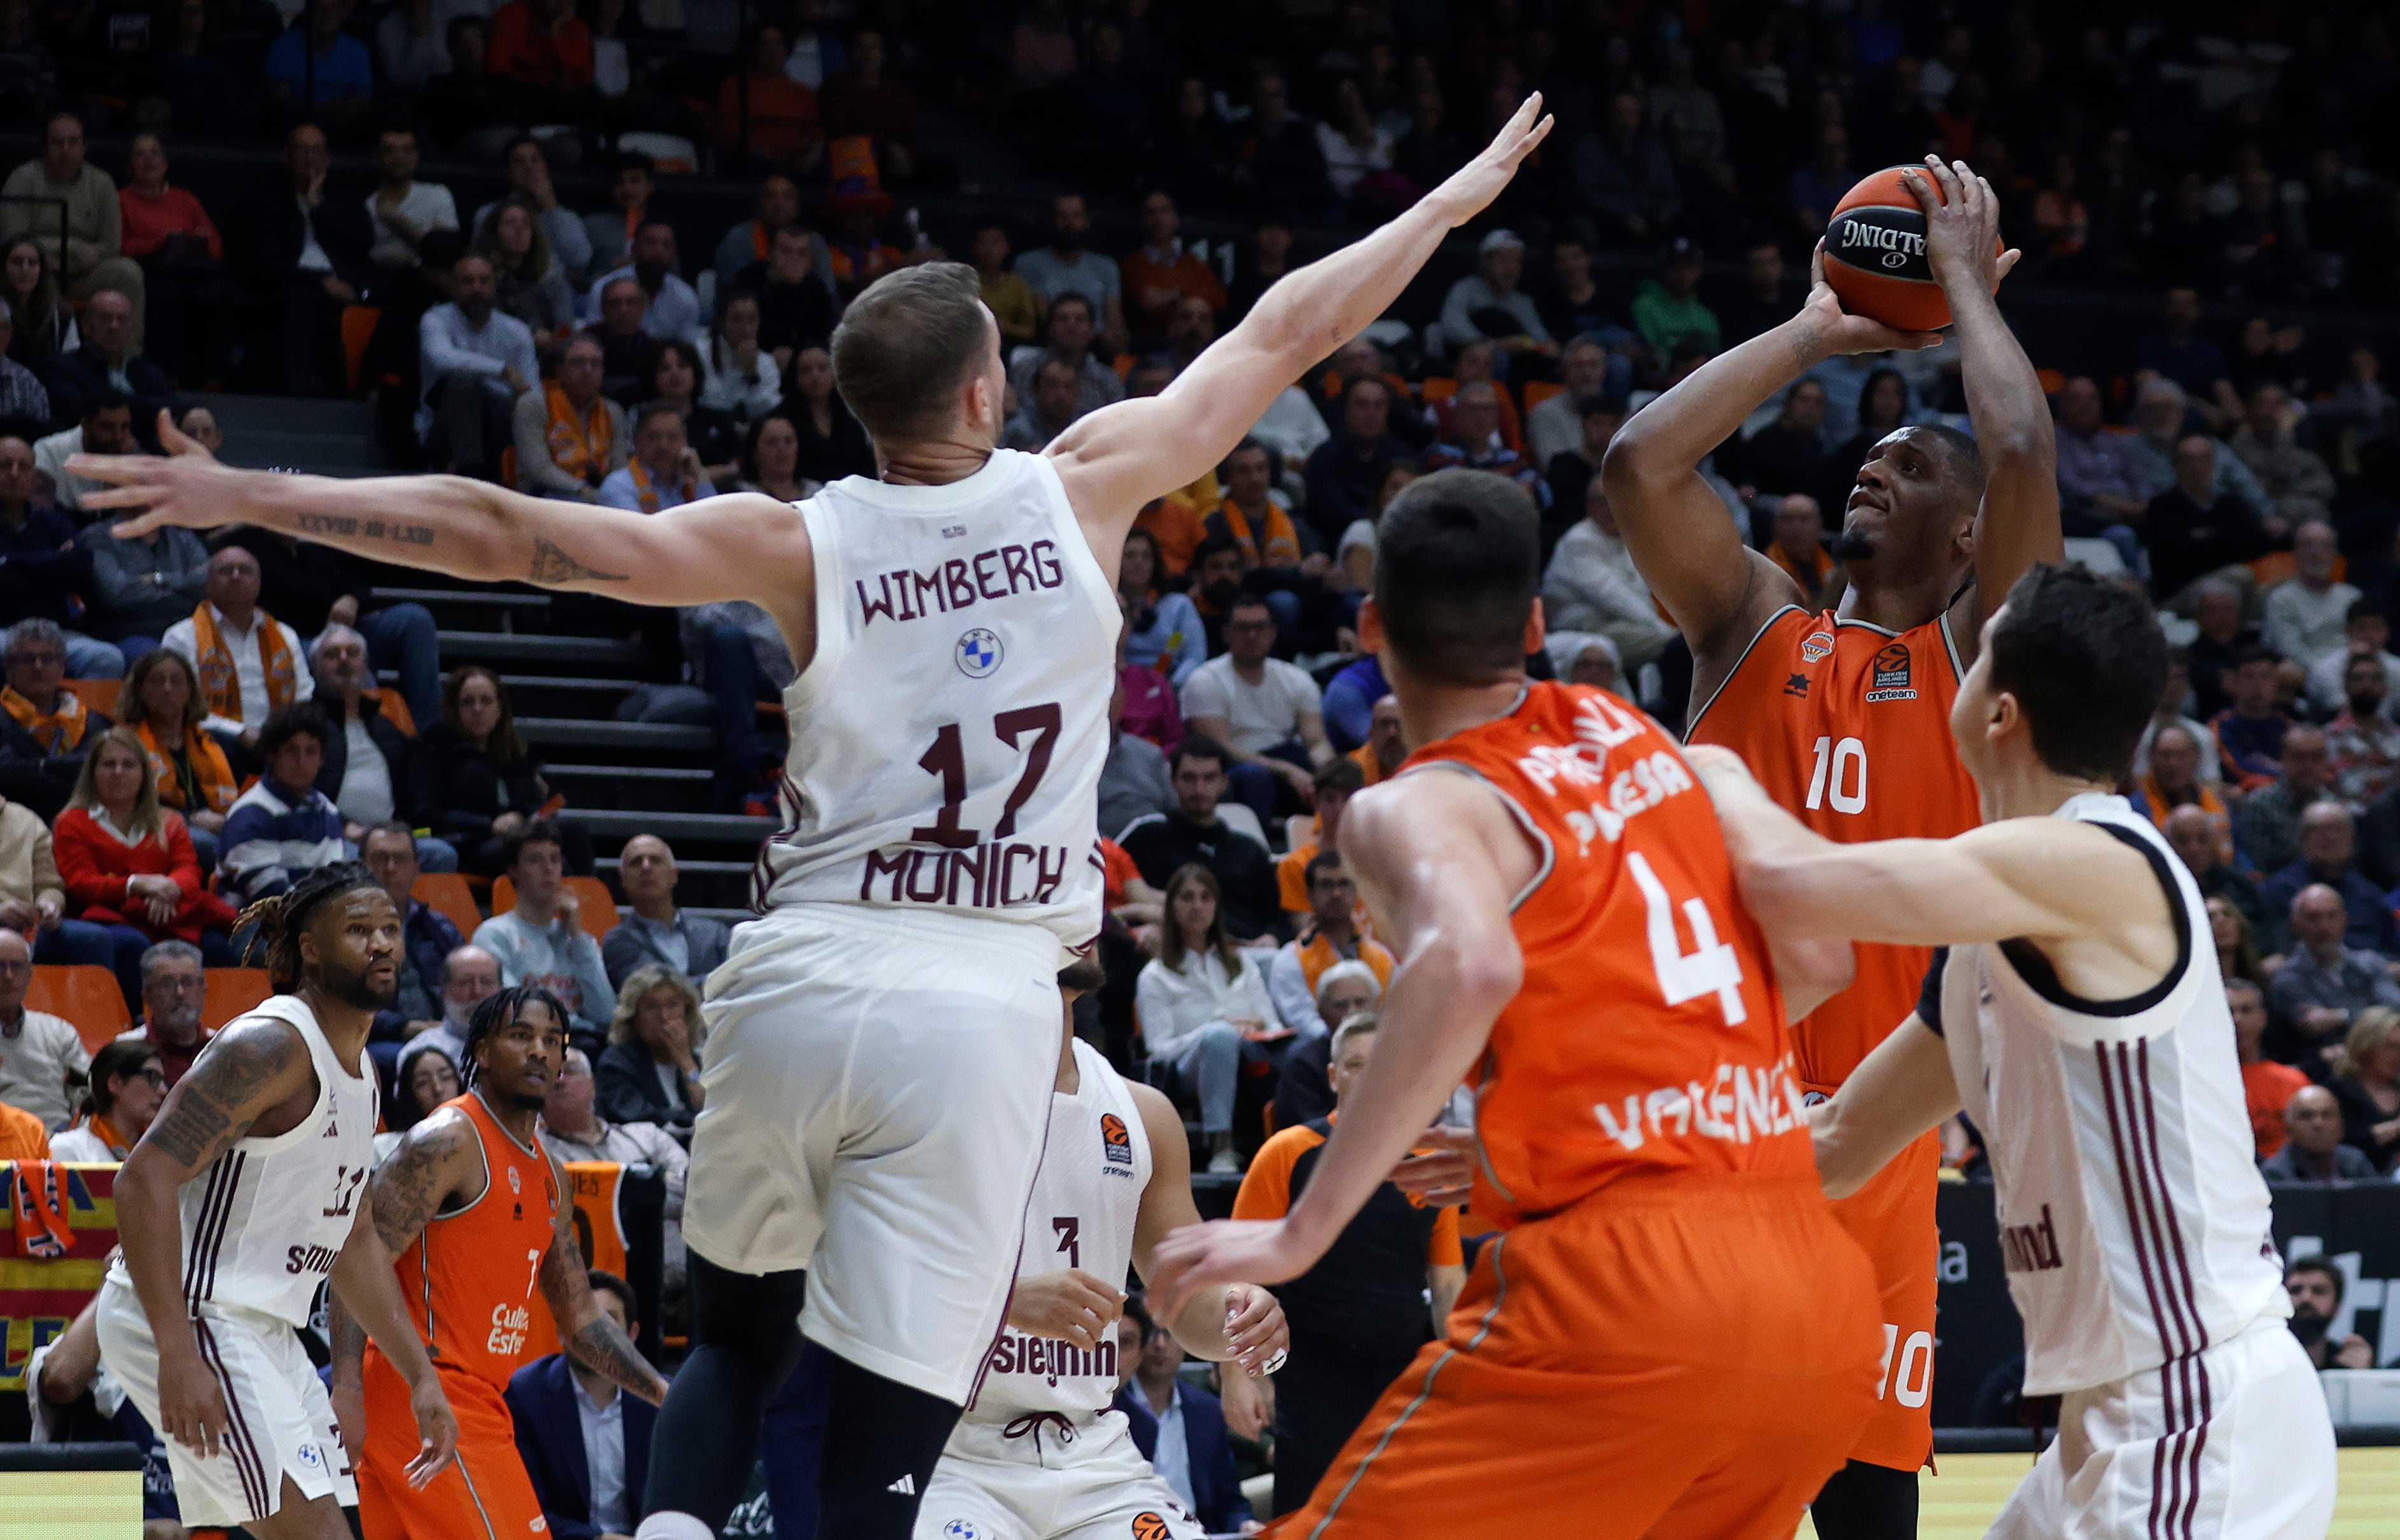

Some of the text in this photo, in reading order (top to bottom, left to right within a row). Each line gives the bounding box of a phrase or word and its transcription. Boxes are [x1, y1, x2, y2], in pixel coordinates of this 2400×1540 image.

[856, 539, 1064, 627] WIMBERG
[1867, 689, 1916, 701] oneteam
[911, 702, 1062, 849] 17
[1806, 736, 1867, 814] 10
[861, 843, 1067, 908] MUNICH
[1628, 850, 1747, 1027] 4
[1937, 1241, 1969, 1284] a
